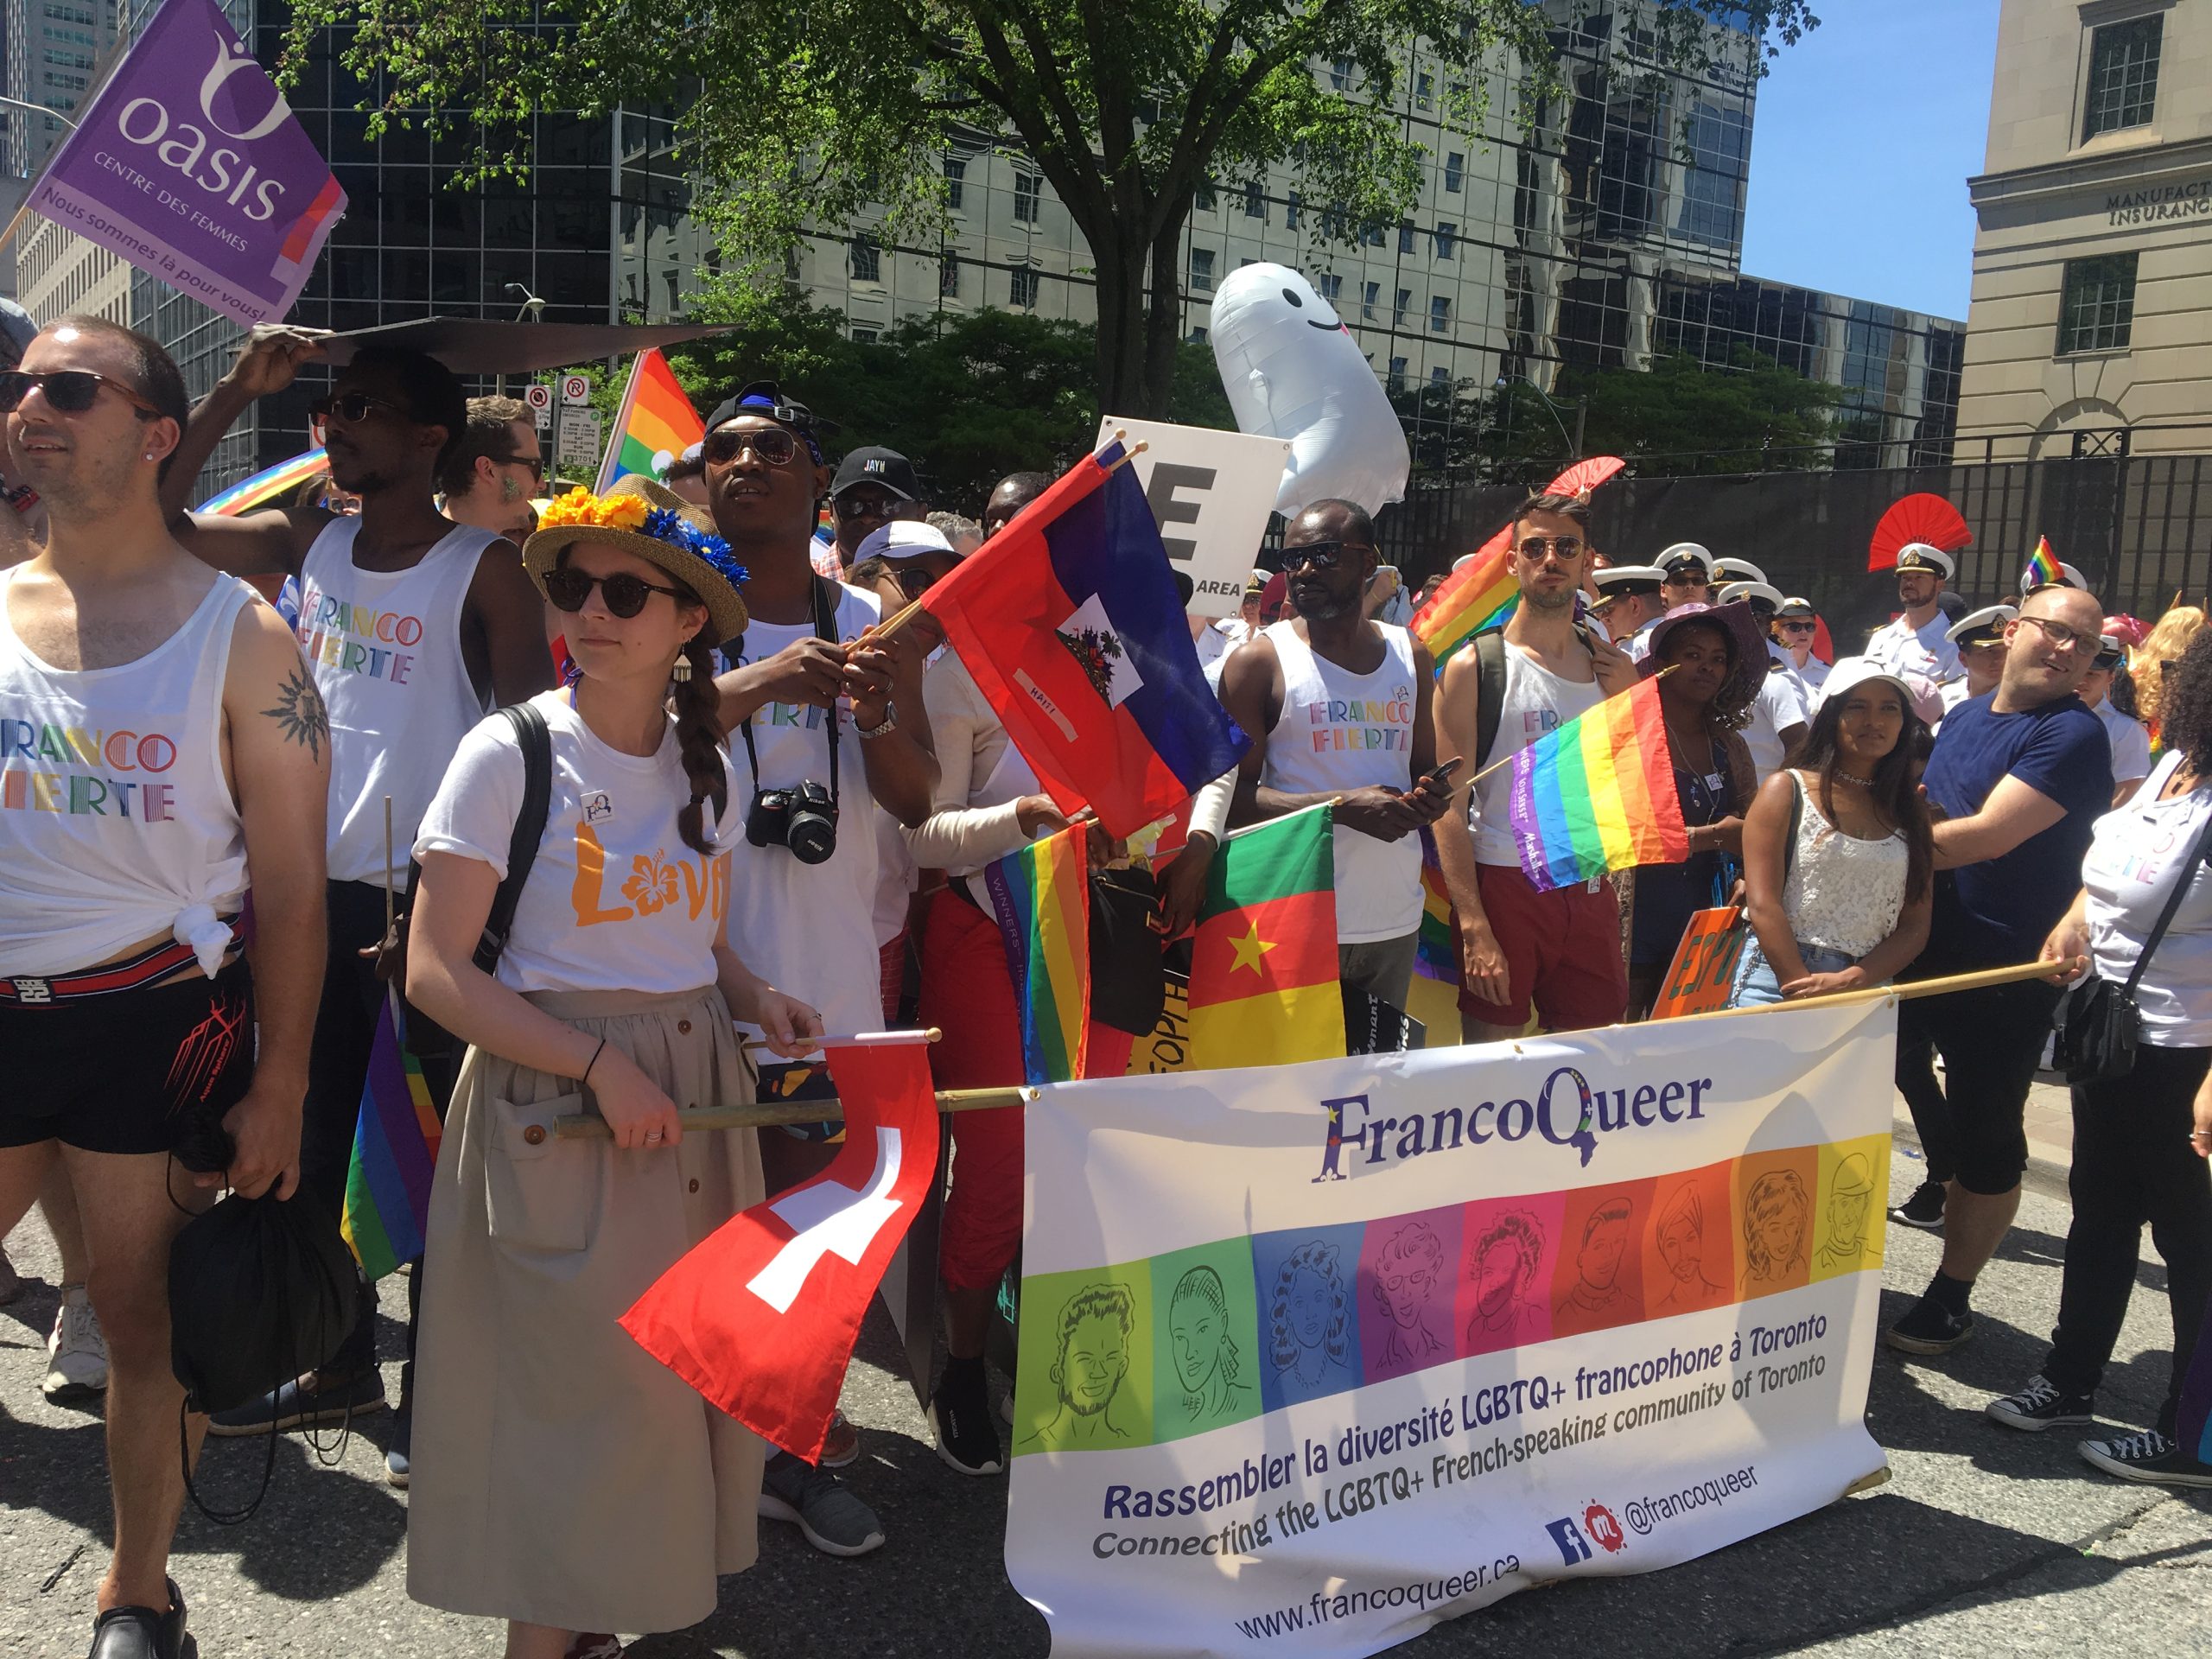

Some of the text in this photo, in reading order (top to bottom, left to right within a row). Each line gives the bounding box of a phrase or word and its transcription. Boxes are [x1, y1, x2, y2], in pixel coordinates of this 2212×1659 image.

[94, 151, 249, 253] CENTRE DES FEMMES
[41, 185, 267, 322] Nous sommes là pour vous!
[303, 590, 423, 647] FRANCO
[1196, 579, 1242, 597] AREA
[1030, 687, 1056, 714] HAITI
[807, 839, 824, 852] Nikon
[994, 877, 1020, 948] WINNERS
[1311, 1067, 1713, 1184] FrancoQueer
[1103, 1314, 1827, 1519] Rassembler la diversité LGBTQ+ francophone à Toronto
[1092, 1353, 1827, 1560] Connecting the LGBTQ+ French-speaking community of Toronto
[1624, 1463, 1759, 1535] @francoqueer
[1235, 1554, 1522, 1641] www.francoqueer.ca
